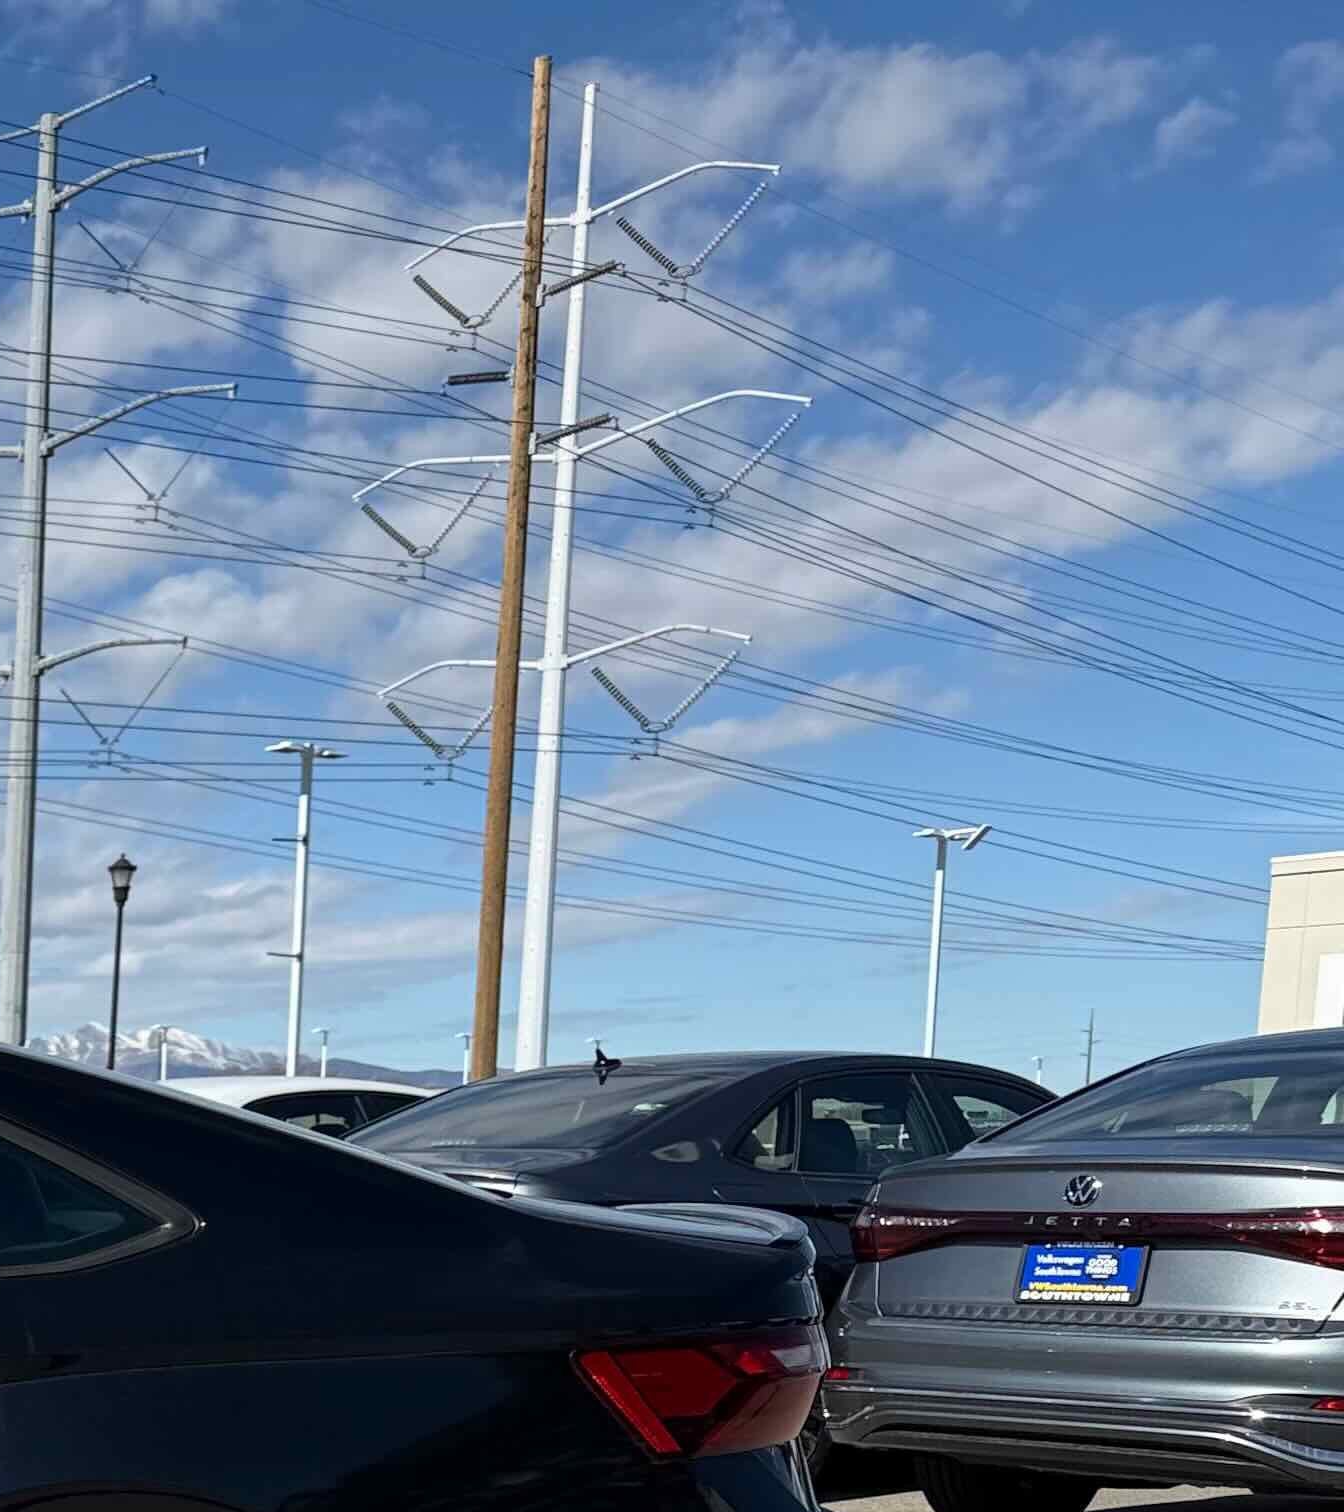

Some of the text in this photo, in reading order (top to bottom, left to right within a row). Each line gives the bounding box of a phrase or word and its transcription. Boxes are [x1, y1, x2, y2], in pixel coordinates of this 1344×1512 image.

[1023, 1215, 1132, 1227] JETTA
[1088, 1258, 1118, 1267] GOOD
[1019, 1290, 1131, 1302] SOUTHTOWNE
